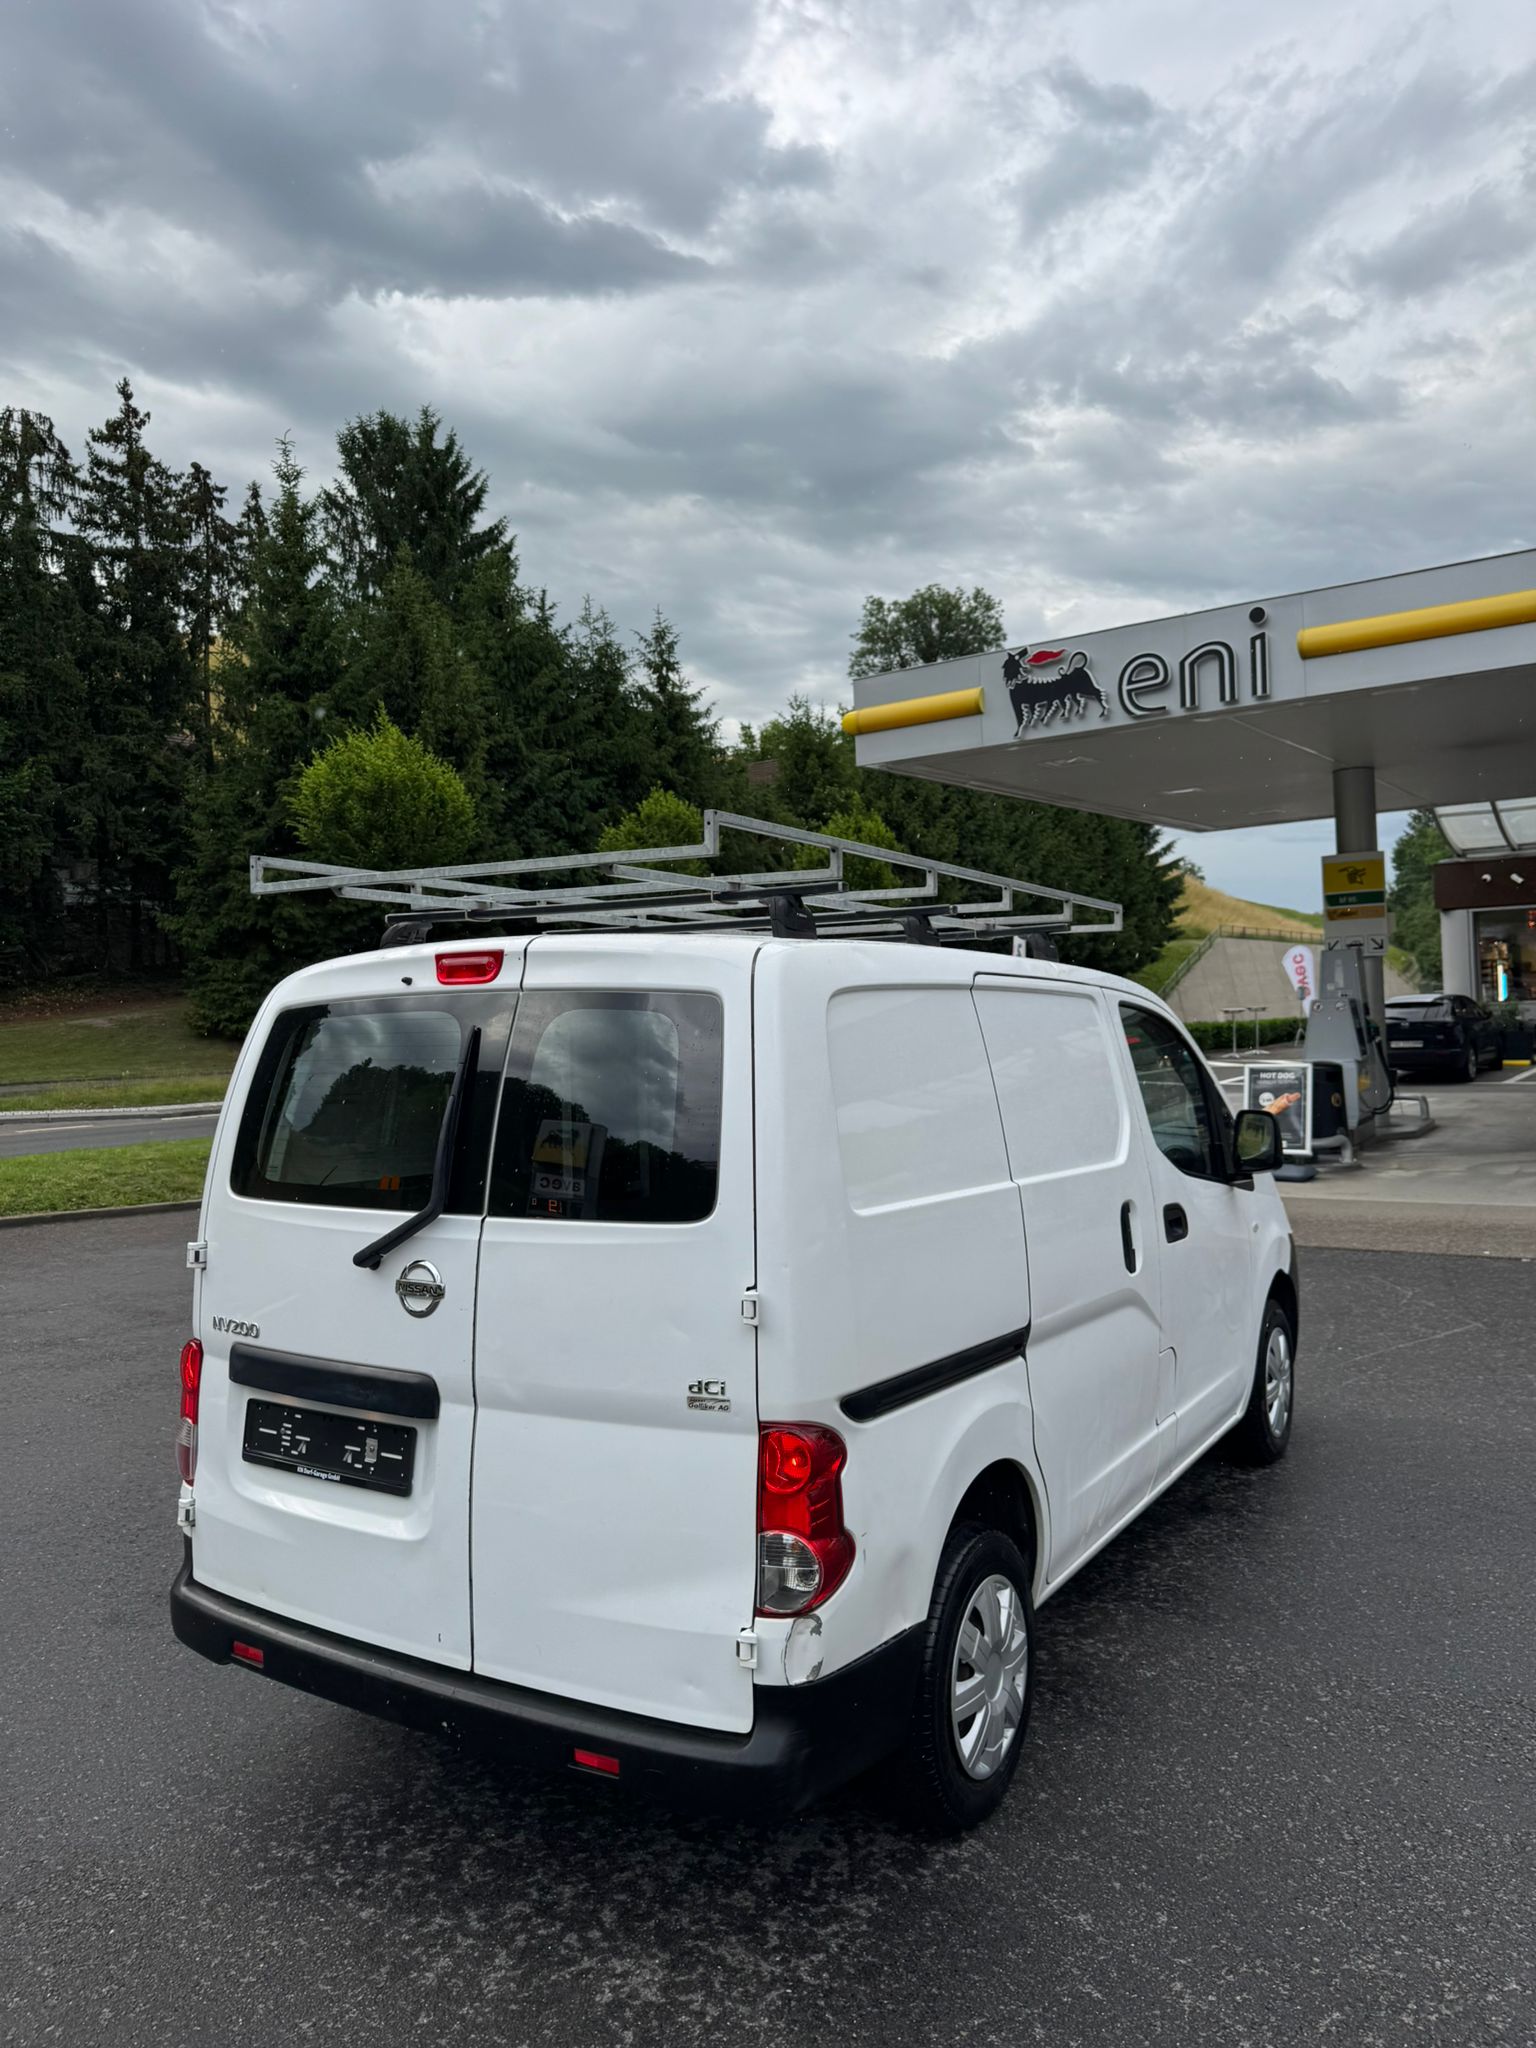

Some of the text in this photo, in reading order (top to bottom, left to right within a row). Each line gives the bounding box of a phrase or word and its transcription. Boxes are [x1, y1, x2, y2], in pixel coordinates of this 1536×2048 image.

[1117, 606, 1269, 718] eni
[399, 1282, 438, 1297] NISSAN
[212, 1315, 260, 1339] NV200
[688, 1379, 726, 1396] dCi
